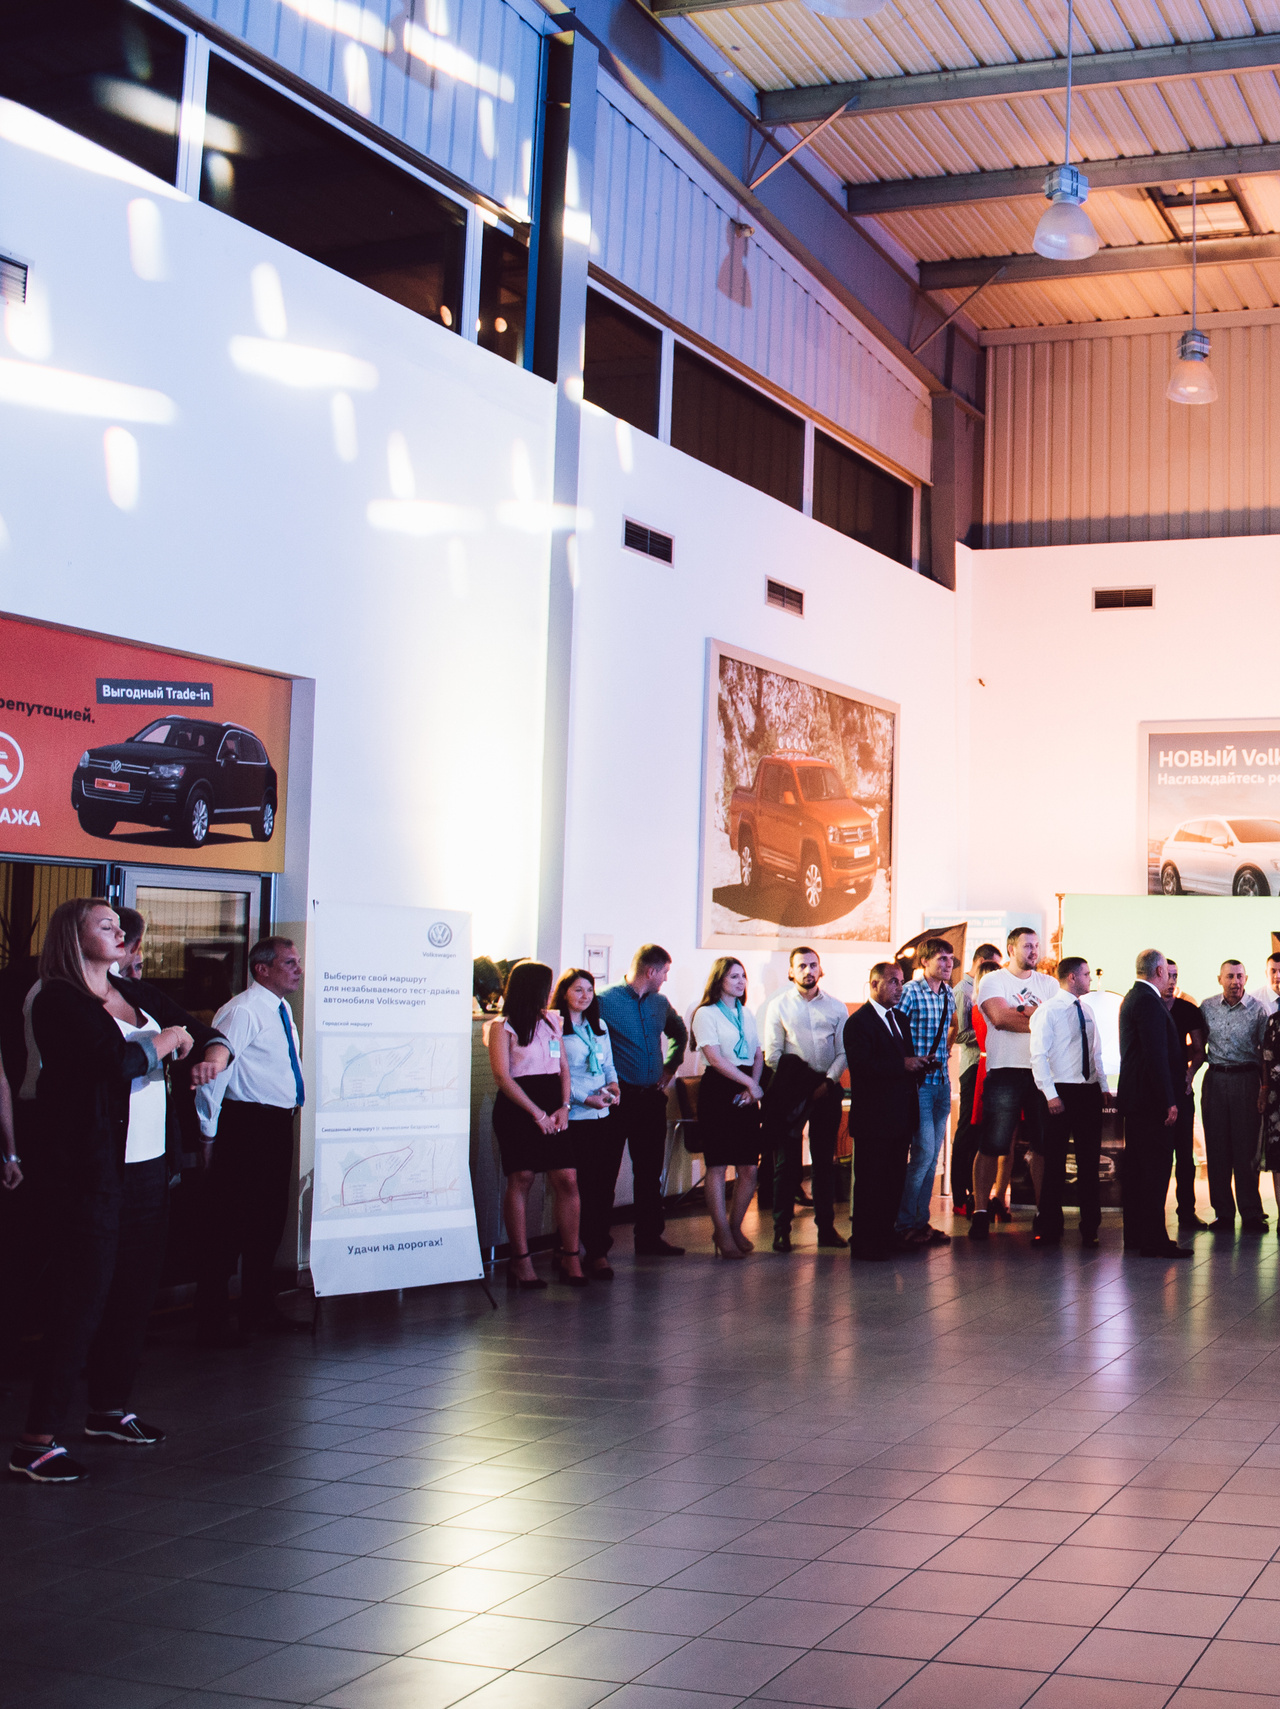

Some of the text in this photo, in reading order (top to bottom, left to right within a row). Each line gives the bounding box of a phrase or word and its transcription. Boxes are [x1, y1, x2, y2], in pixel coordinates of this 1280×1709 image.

[102, 684, 210, 701] Выгодный Trade-in
[1159, 745, 1237, 768] НОВЫЙ
[1157, 771, 1265, 786] Наслаждайтесь
[422, 951, 457, 959] Volkswagen
[323, 971, 427, 984] Выберите свой маршрут
[323, 983, 460, 996] для незабываемого тест-драйва
[323, 996, 426, 1007] автомобиля Volkswagen
[347, 1237, 443, 1255] Удачи на дорогах!
